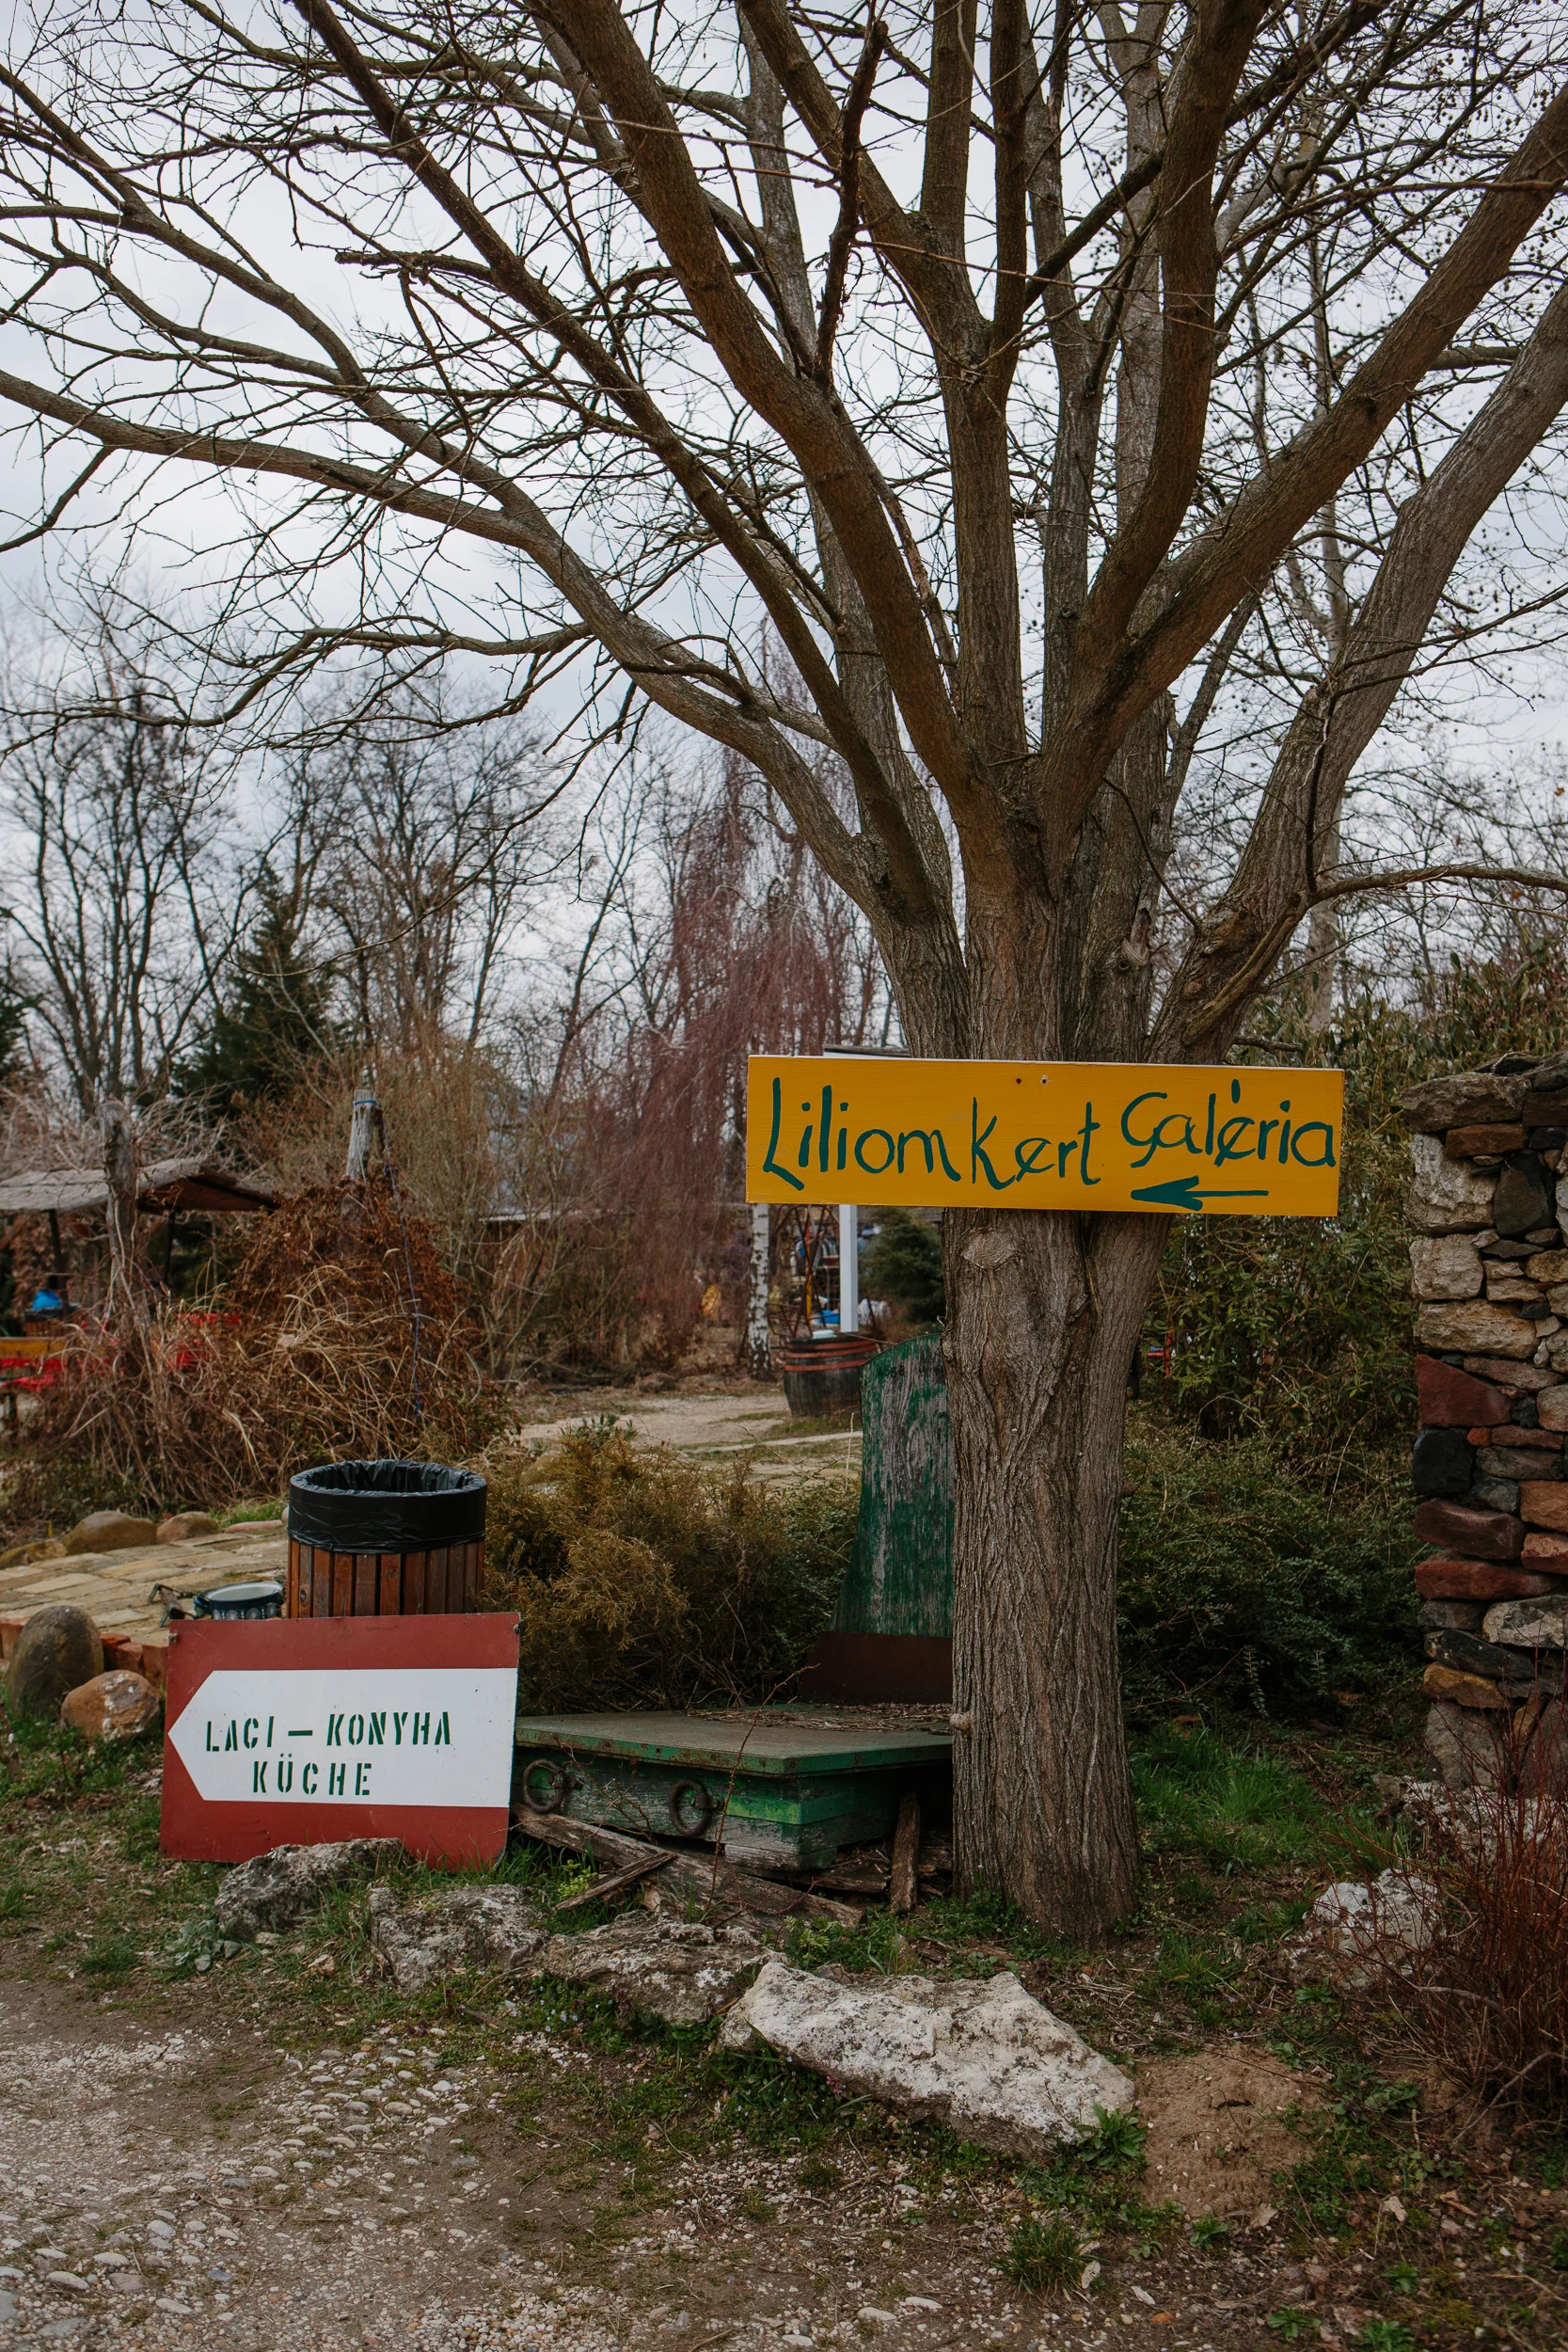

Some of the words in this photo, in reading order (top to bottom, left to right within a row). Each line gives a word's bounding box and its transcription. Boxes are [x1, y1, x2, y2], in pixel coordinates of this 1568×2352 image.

[1120, 1078, 1338, 1169] Galéria
[205, 1715, 276, 1753] LACI
[325, 1711, 451, 1747] KONYHA
[252, 1753, 372, 1797] KÜCHE
